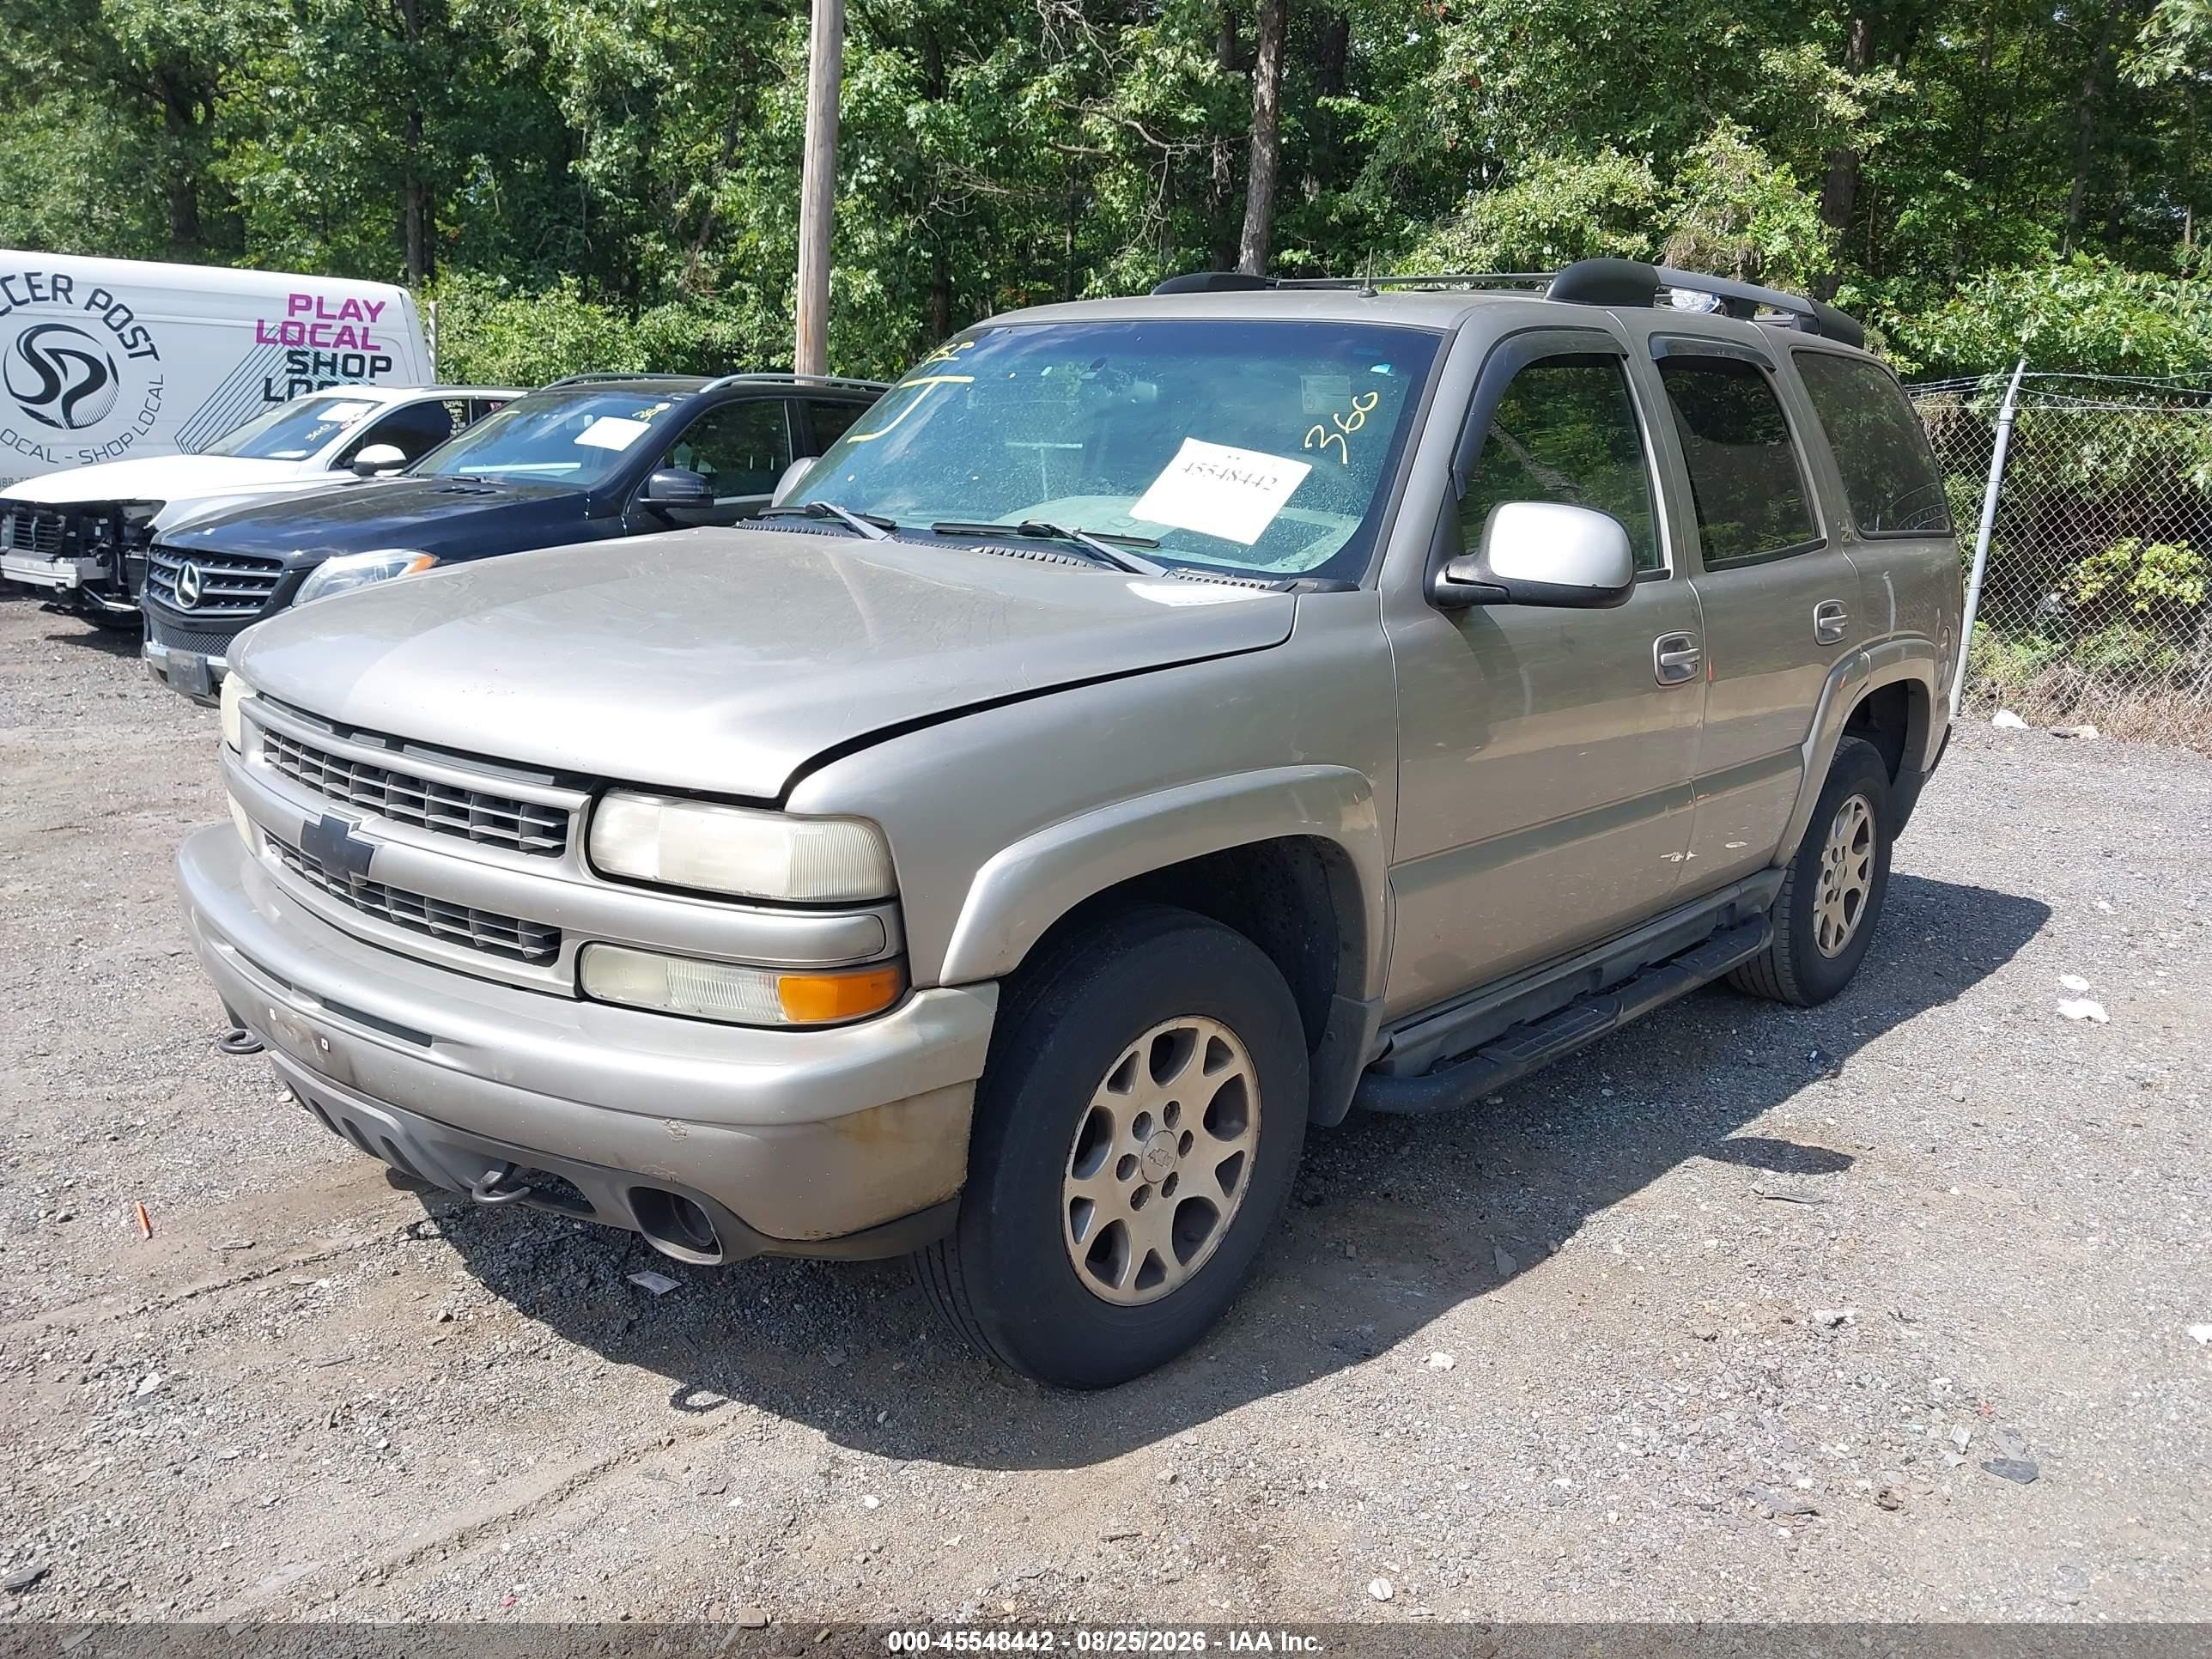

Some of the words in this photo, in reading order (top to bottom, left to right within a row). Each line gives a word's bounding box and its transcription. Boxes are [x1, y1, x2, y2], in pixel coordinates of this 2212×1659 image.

[289, 294, 386, 323] PLAY
[84, 289, 161, 362] POST
[256, 319, 381, 351] LOCAL
[285, 349, 392, 379] SHOP
[78, 432, 134, 465] SHOP
[131, 374, 163, 436] LOCAL
